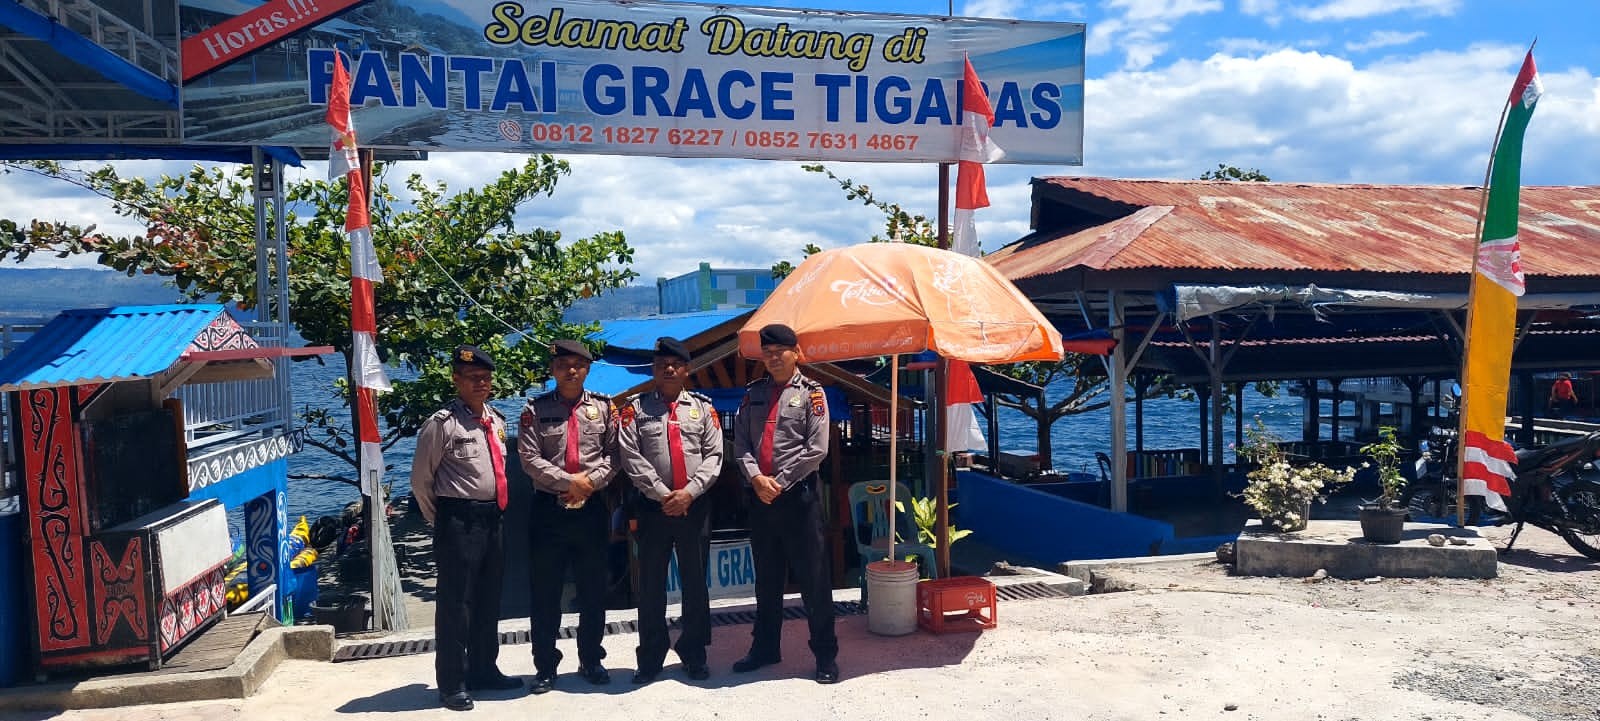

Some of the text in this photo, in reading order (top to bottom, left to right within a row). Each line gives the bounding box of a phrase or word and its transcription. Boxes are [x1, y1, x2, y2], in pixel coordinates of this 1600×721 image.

[484, 1, 928, 72] Selamat Datang di
[308, 48, 557, 113] PANTAI
[582, 62, 795, 122] GRACE
[532, 124, 593, 143] 0812
[602, 126, 659, 144] 1827
[667, 128, 724, 146] 6227
[745, 130, 800, 148] 0852
[807, 132, 858, 149] 7631
[866, 134, 920, 151] 4867
